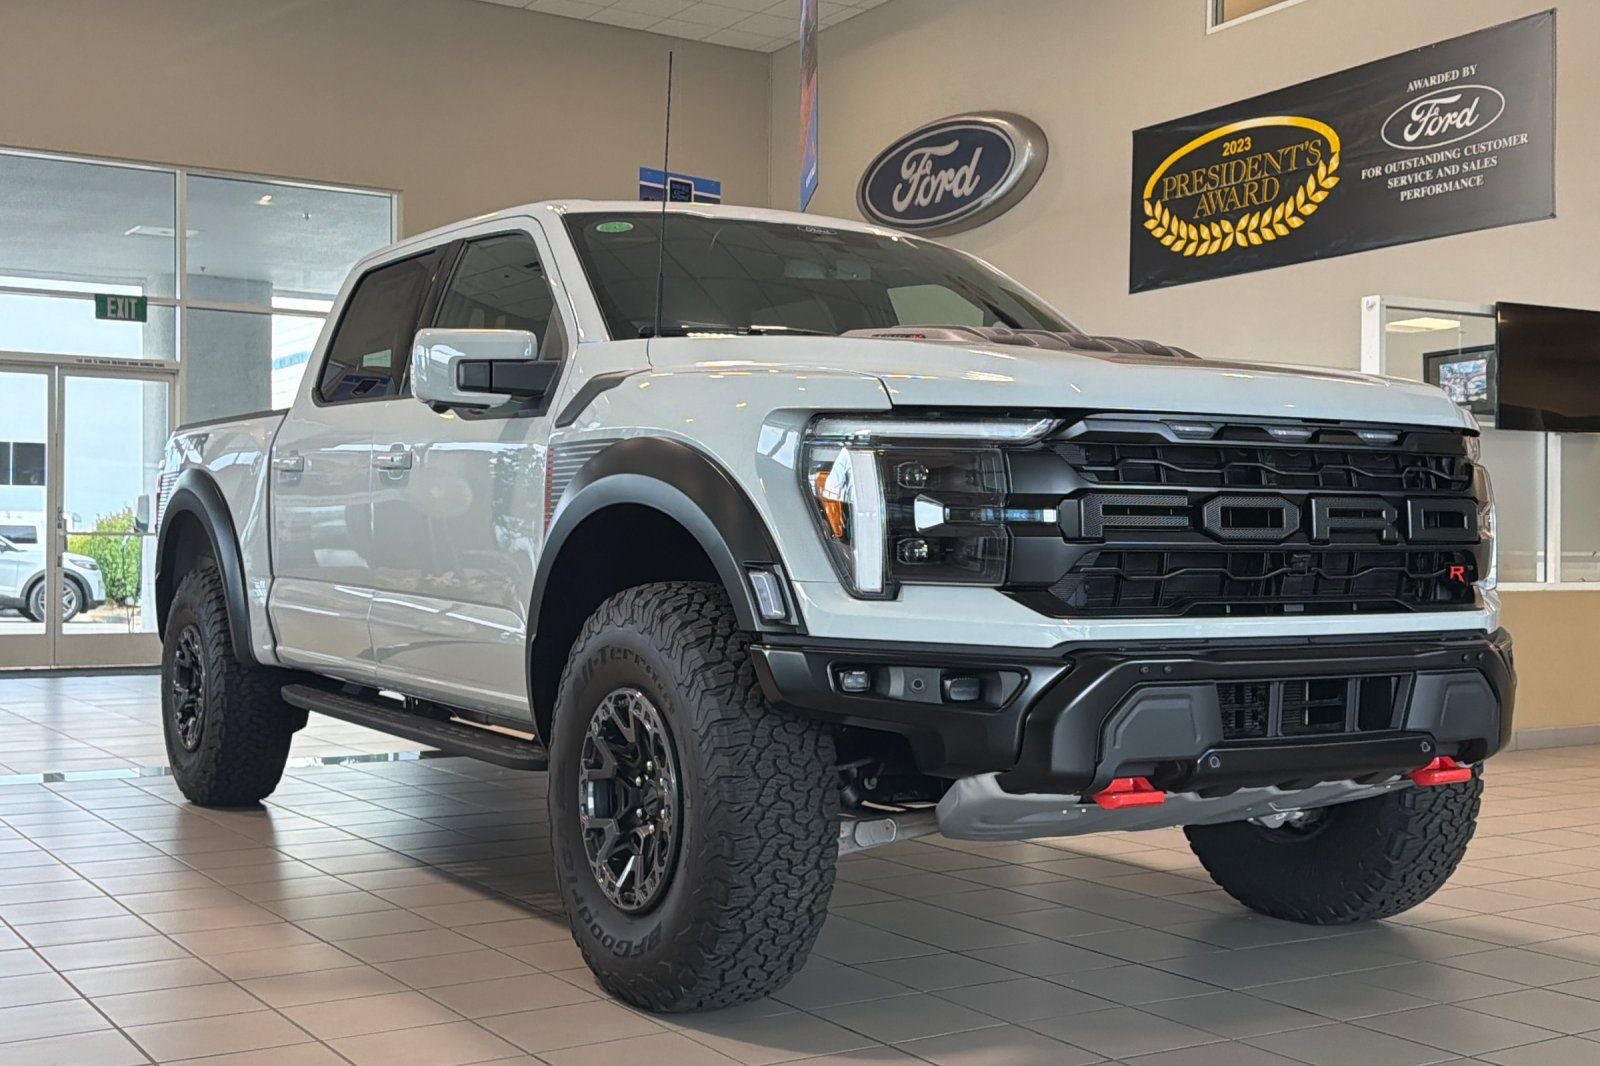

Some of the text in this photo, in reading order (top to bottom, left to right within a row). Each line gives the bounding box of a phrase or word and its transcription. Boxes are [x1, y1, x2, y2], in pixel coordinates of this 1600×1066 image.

[1407, 64, 1478, 93] AWARDED BY
[1403, 93, 1481, 142] Ford
[1222, 136, 1252, 157] 2023
[1361, 133, 1529, 180] FOR OUTSTANDING CUSTOMER
[892, 139, 984, 213] Ford
[1162, 139, 1322, 202] PRESIDENT'S
[1387, 155, 1498, 189] SERVICE AND SALES
[1400, 174, 1485, 202] PERFORMANCE
[1193, 176, 1280, 219] AWARD
[107, 296, 138, 320] EXIT
[1080, 490, 1480, 545] FORD
[1450, 565, 1466, 584] R
[560, 838, 662, 958] BFGoodric
